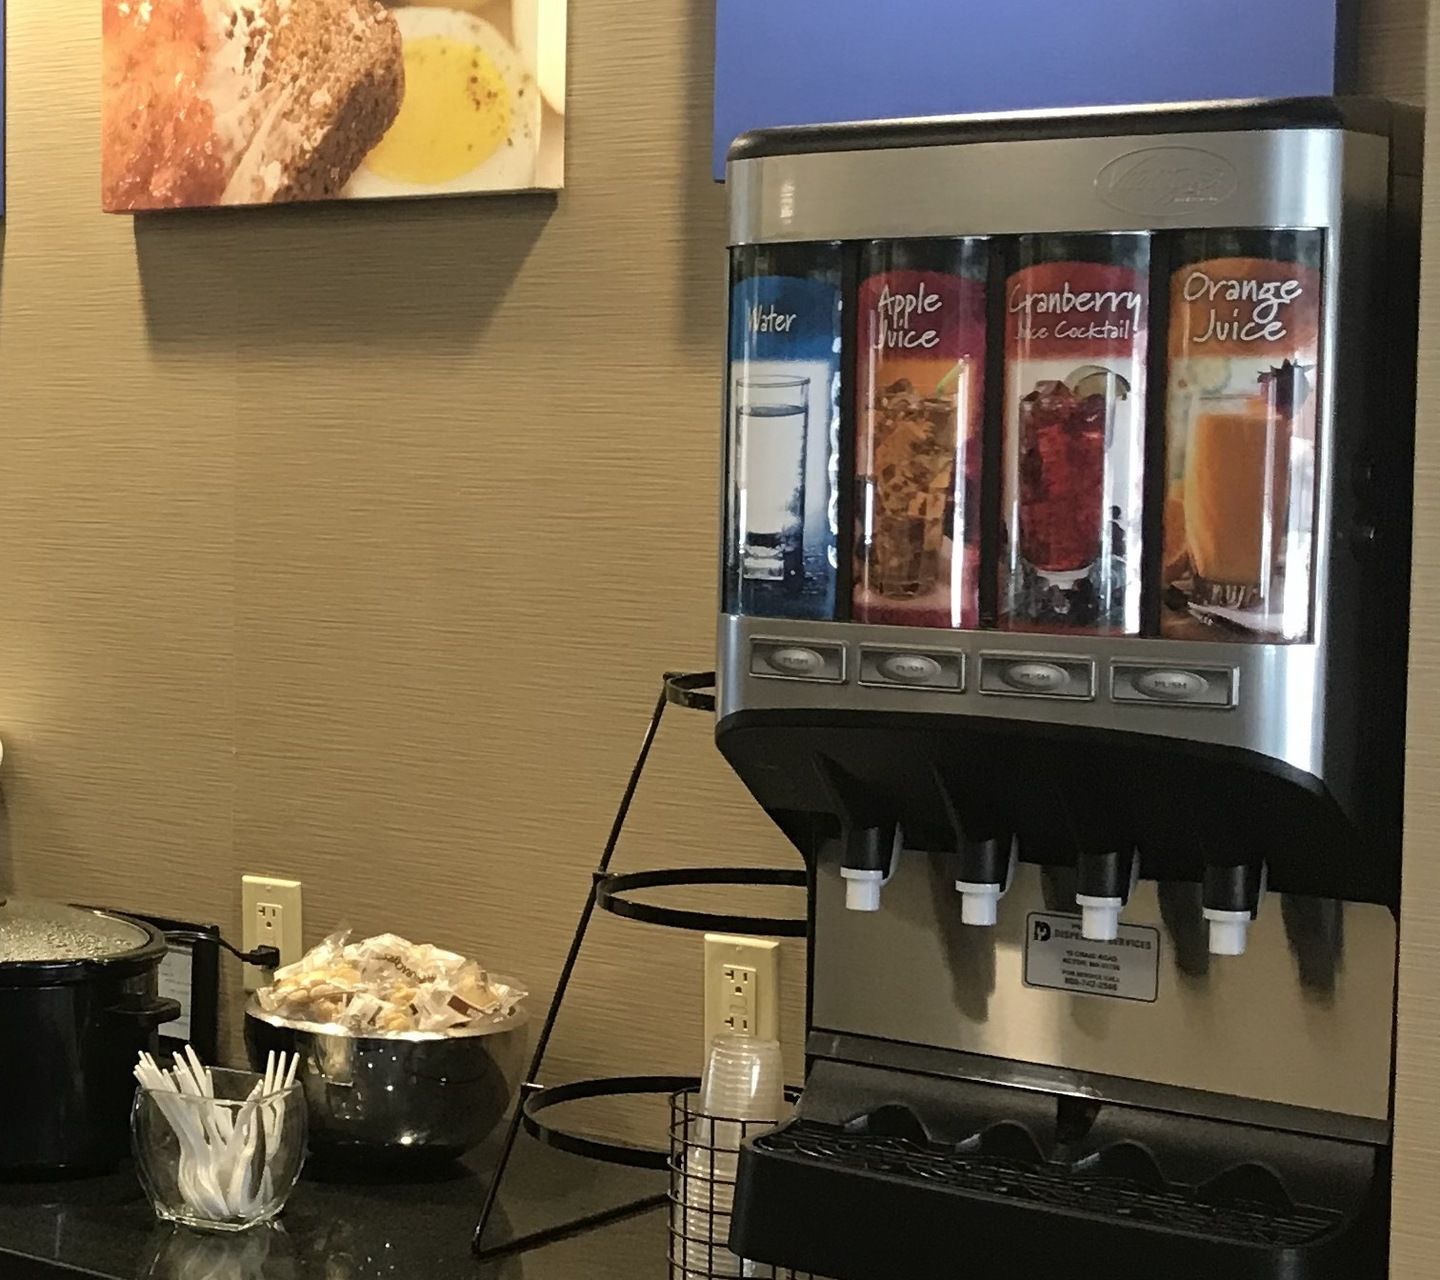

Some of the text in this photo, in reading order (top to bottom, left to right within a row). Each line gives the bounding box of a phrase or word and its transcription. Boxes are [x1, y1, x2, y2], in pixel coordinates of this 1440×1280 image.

[877, 282, 943, 329] Apple
[1008, 281, 1142, 331] Cranberry
[1183, 272, 1302, 324] Orange
[748, 304, 797, 332] Water
[873, 318, 941, 349] Juice
[1053, 320, 1131, 340] Cocktail
[1193, 308, 1287, 344] Juice
